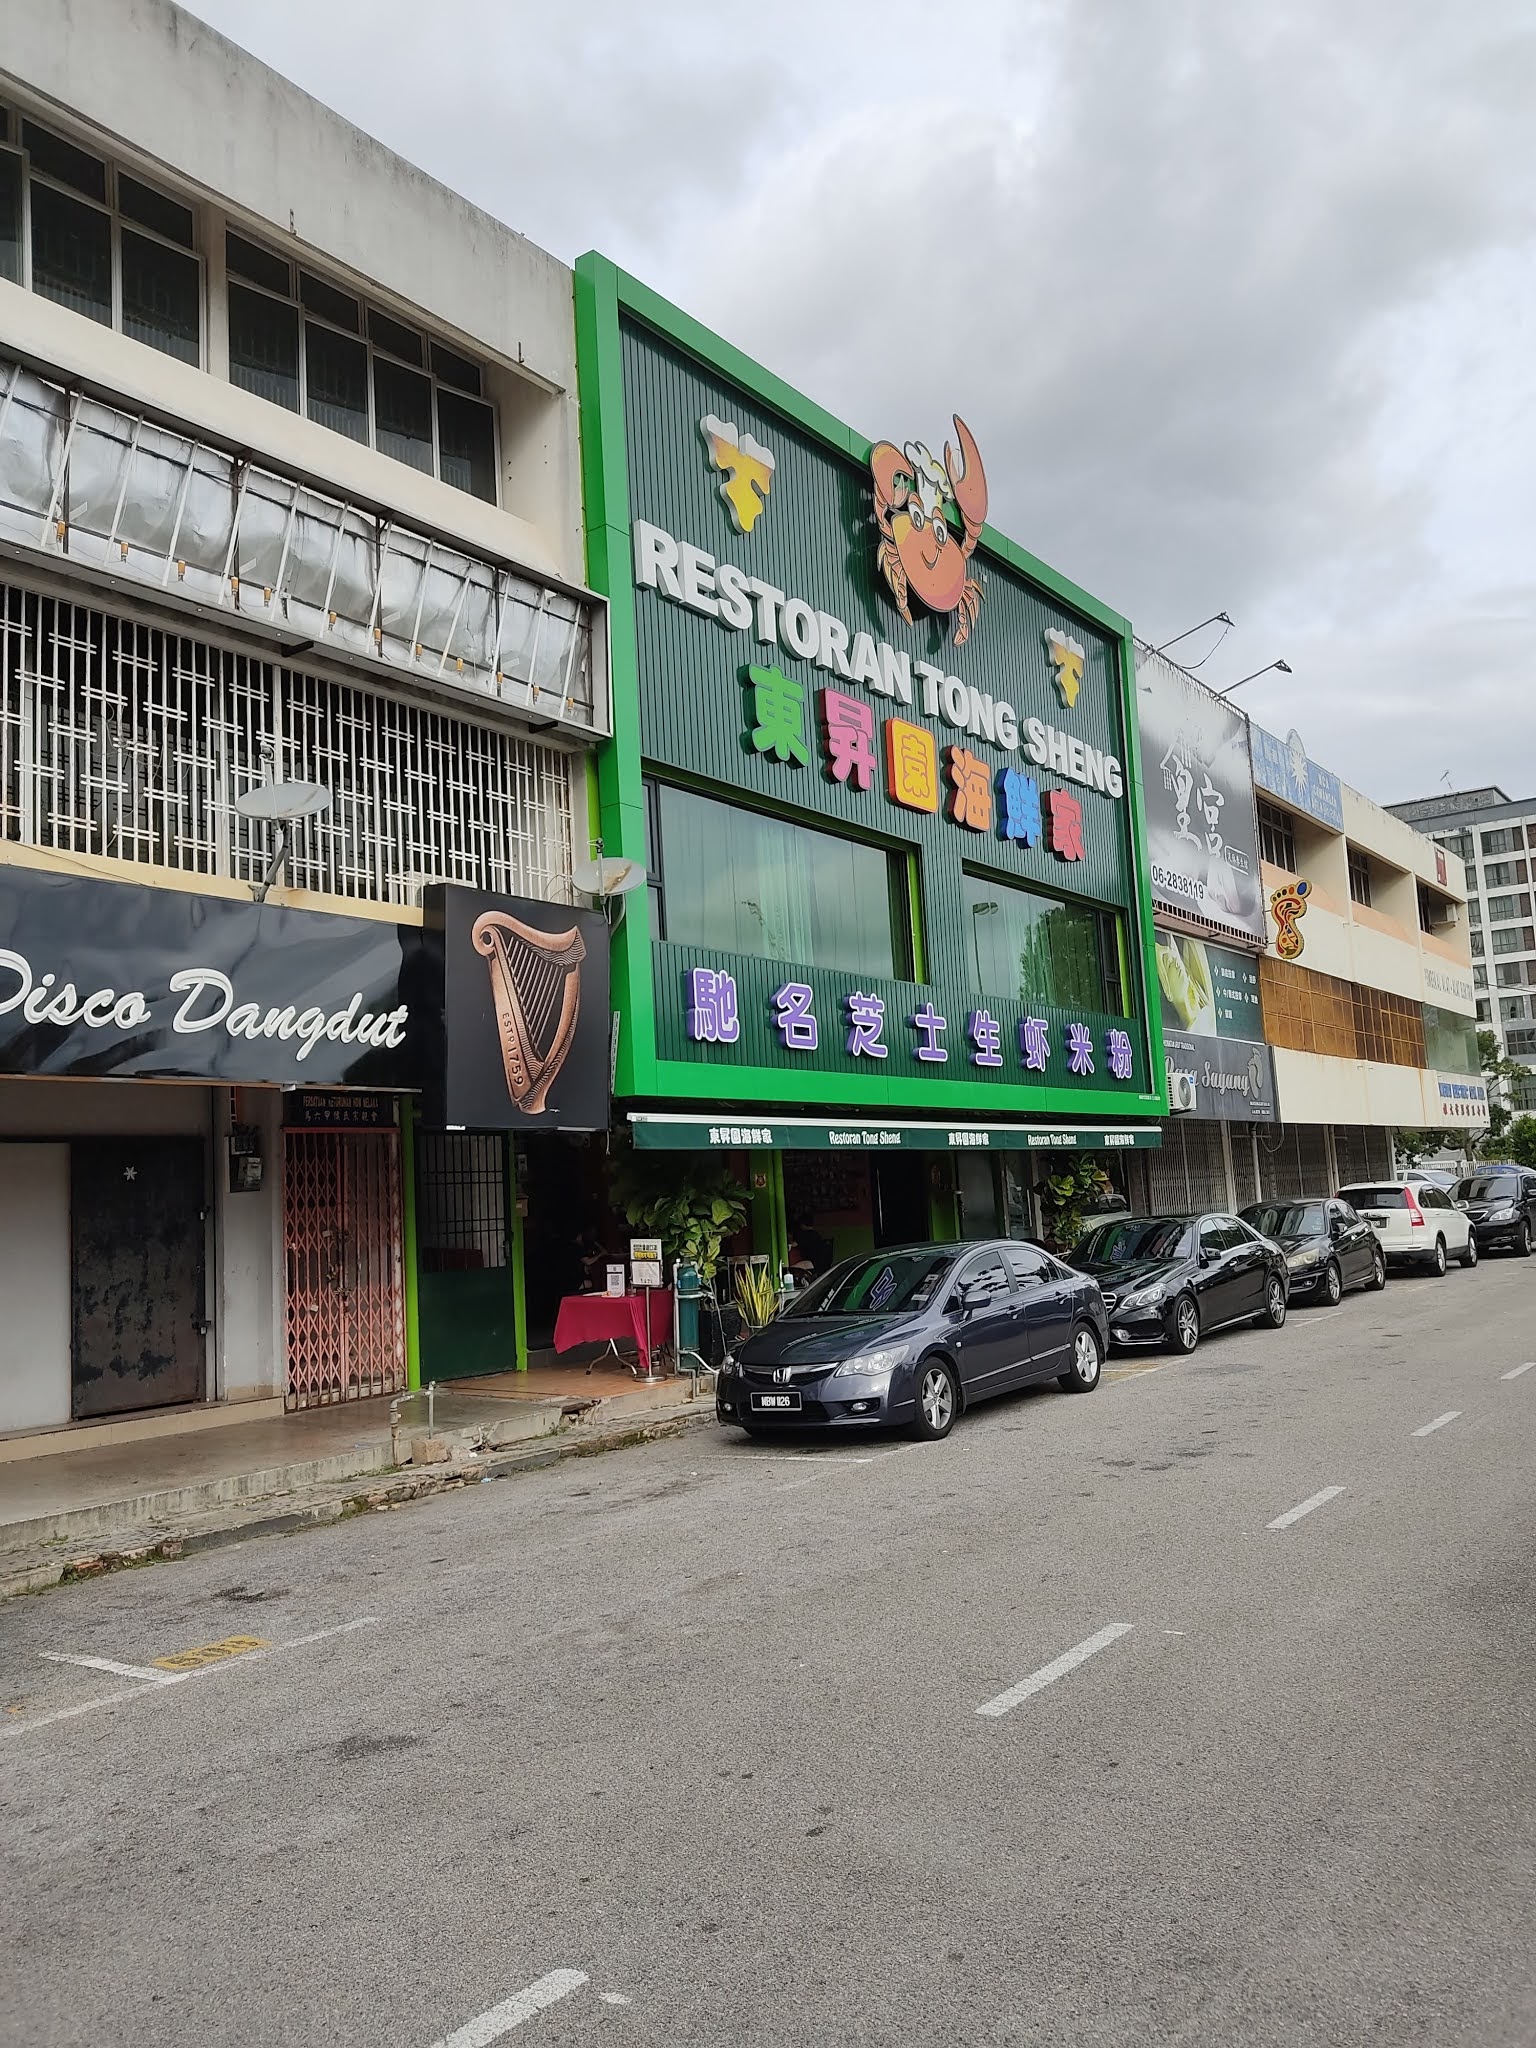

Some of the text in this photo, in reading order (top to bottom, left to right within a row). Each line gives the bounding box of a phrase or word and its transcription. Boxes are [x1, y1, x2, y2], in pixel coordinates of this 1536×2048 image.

[633, 519, 1123, 799] RESTORAN TONG SHENG
[745, 663, 1086, 862] 東昇園海鮮家
[1152, 864, 1205, 900] 06-2838119
[169, 967, 409, 1062] Dangdut
[689, 967, 1133, 1079] 馳名芝士生虾米粉
[507, 1047, 524, 1086] 1759
[1201, 1061, 1250, 1097] Sayang
[829, 1131, 901, 1146] Restoran Tong Sheng
